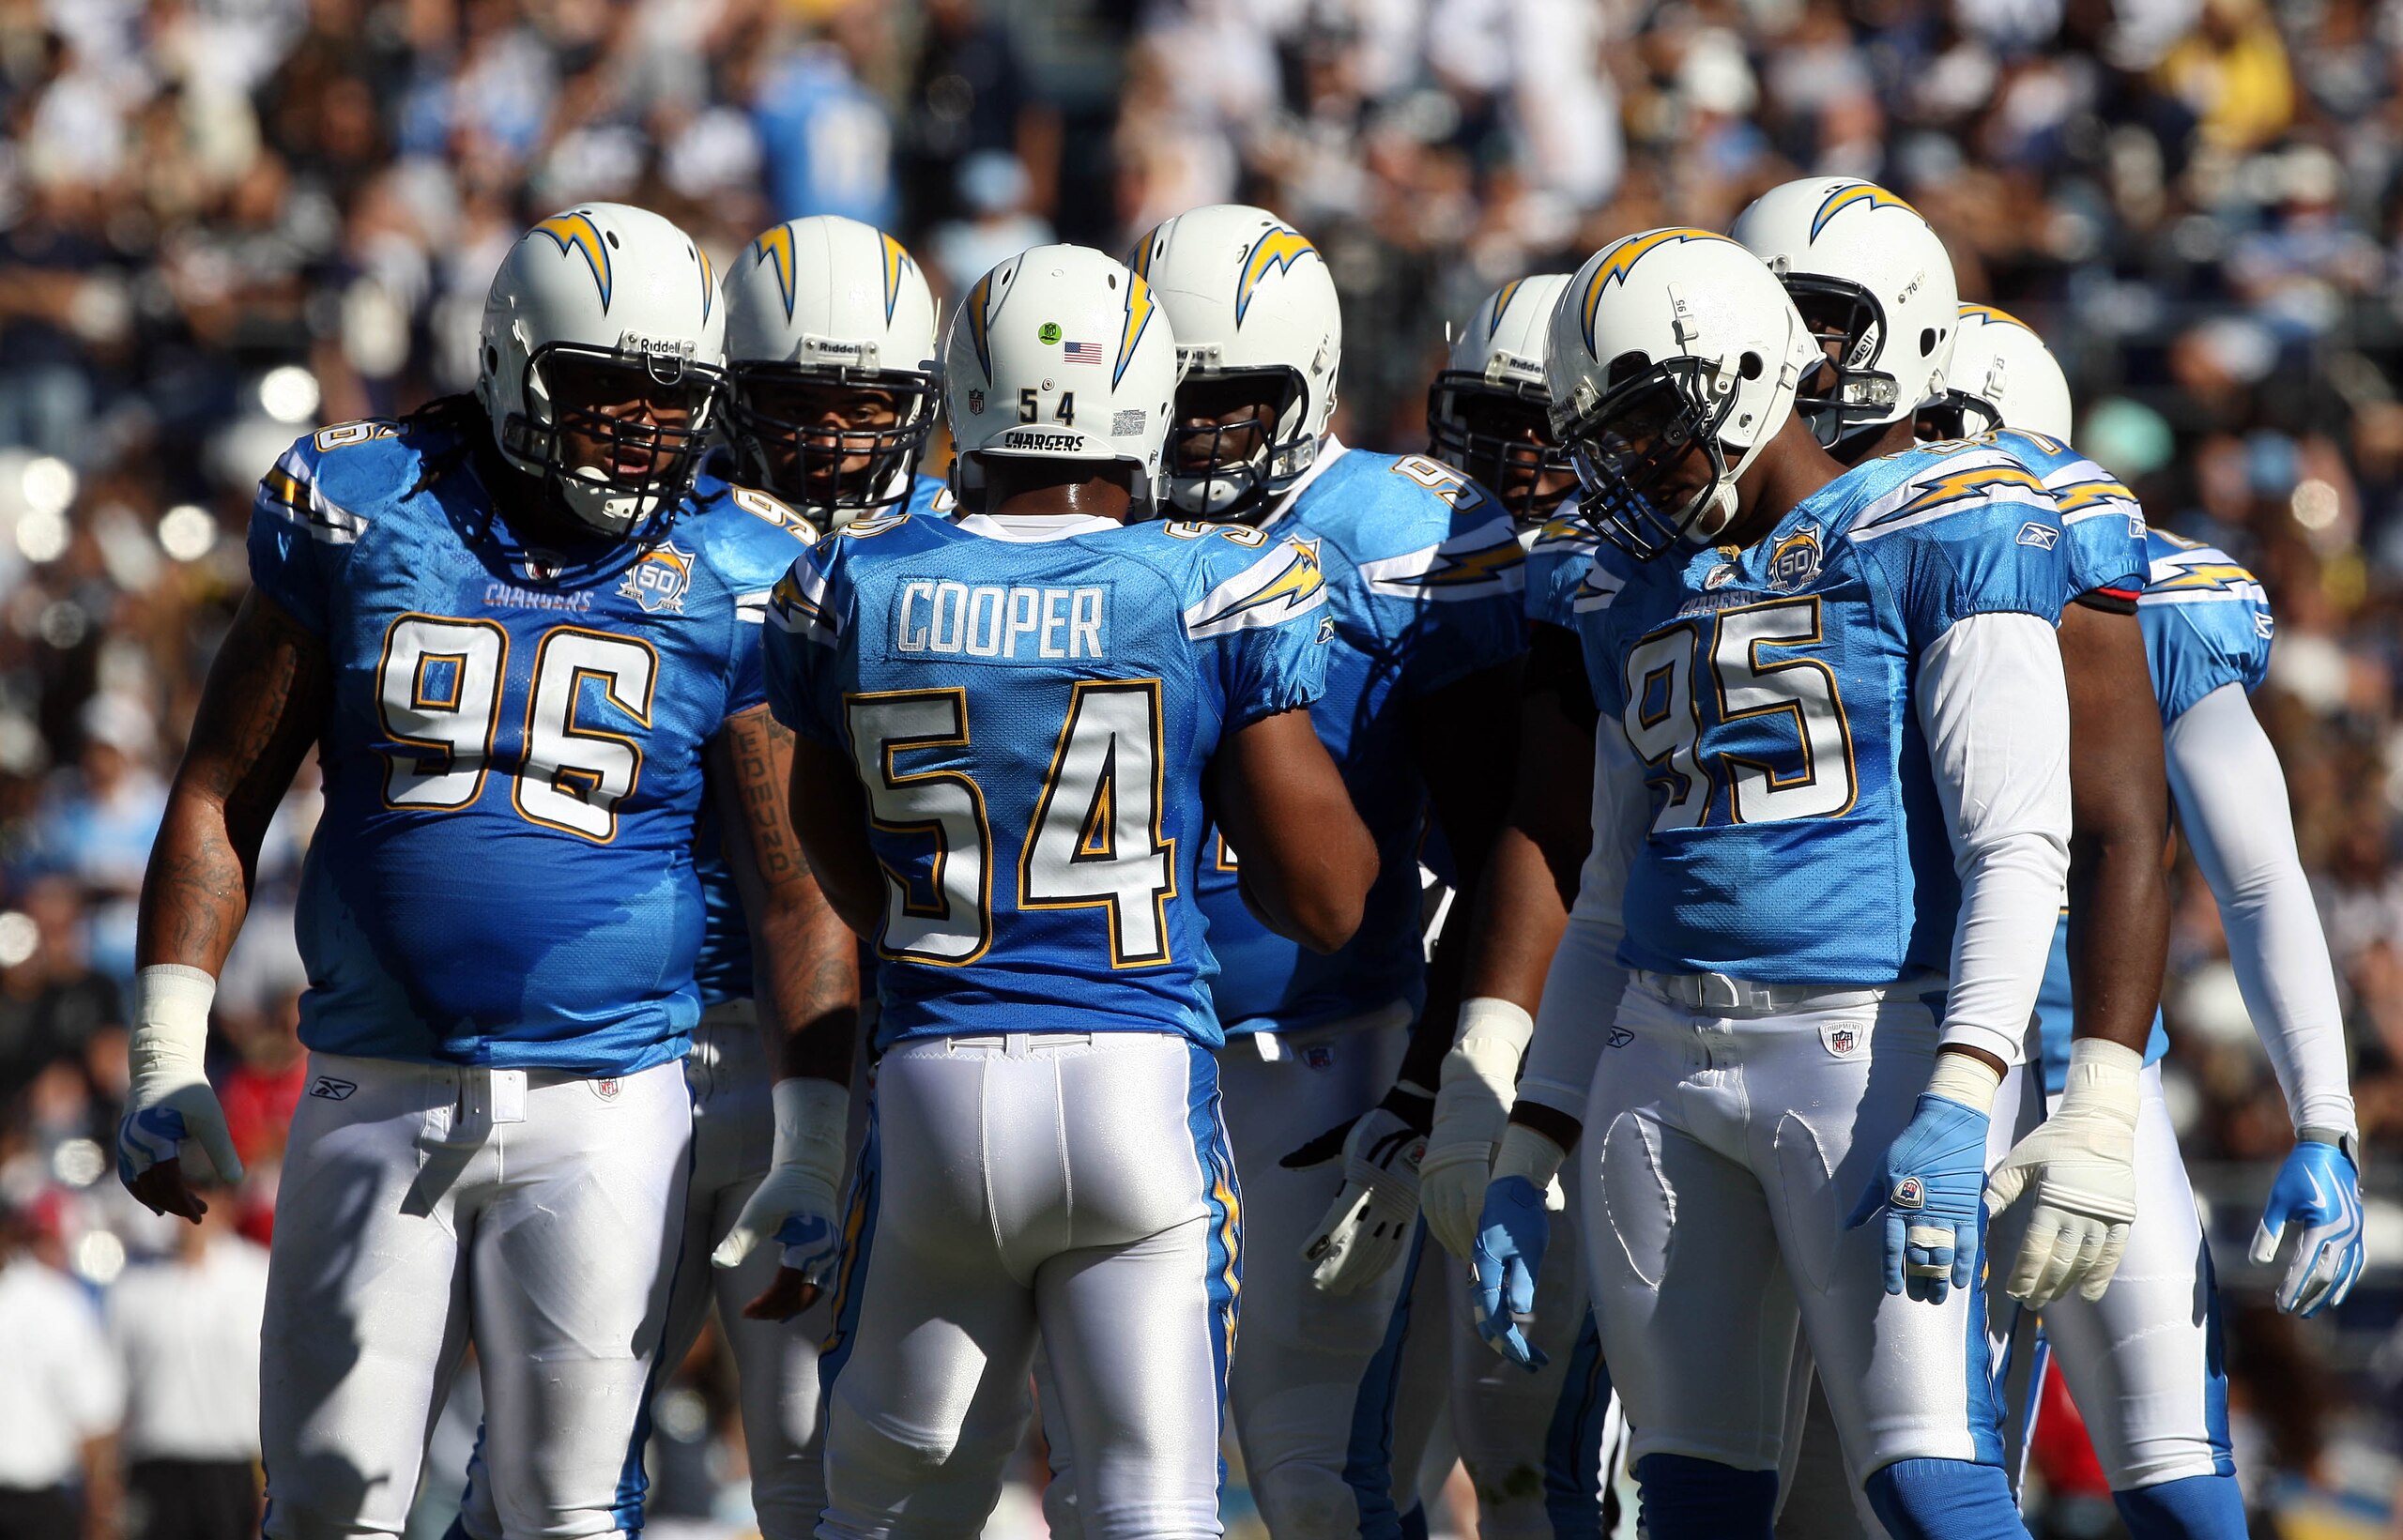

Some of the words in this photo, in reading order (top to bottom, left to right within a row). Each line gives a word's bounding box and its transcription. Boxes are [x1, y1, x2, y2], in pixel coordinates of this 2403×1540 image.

[1907, 282, 1918, 296] 70
[640, 339, 681, 354] Riddell
[819, 343, 862, 354] Riddell
[1004, 432, 1085, 452] CHARGERS
[1780, 549, 1810, 574] 50
[639, 565, 677, 594] 50
[897, 581, 1105, 659] COOPER
[375, 611, 660, 845] 96
[1623, 594, 1859, 841] 95
[842, 678, 1178, 970] 54
[1833, 1041, 1852, 1052] NFL
[601, 1082, 617, 1094] NFL
